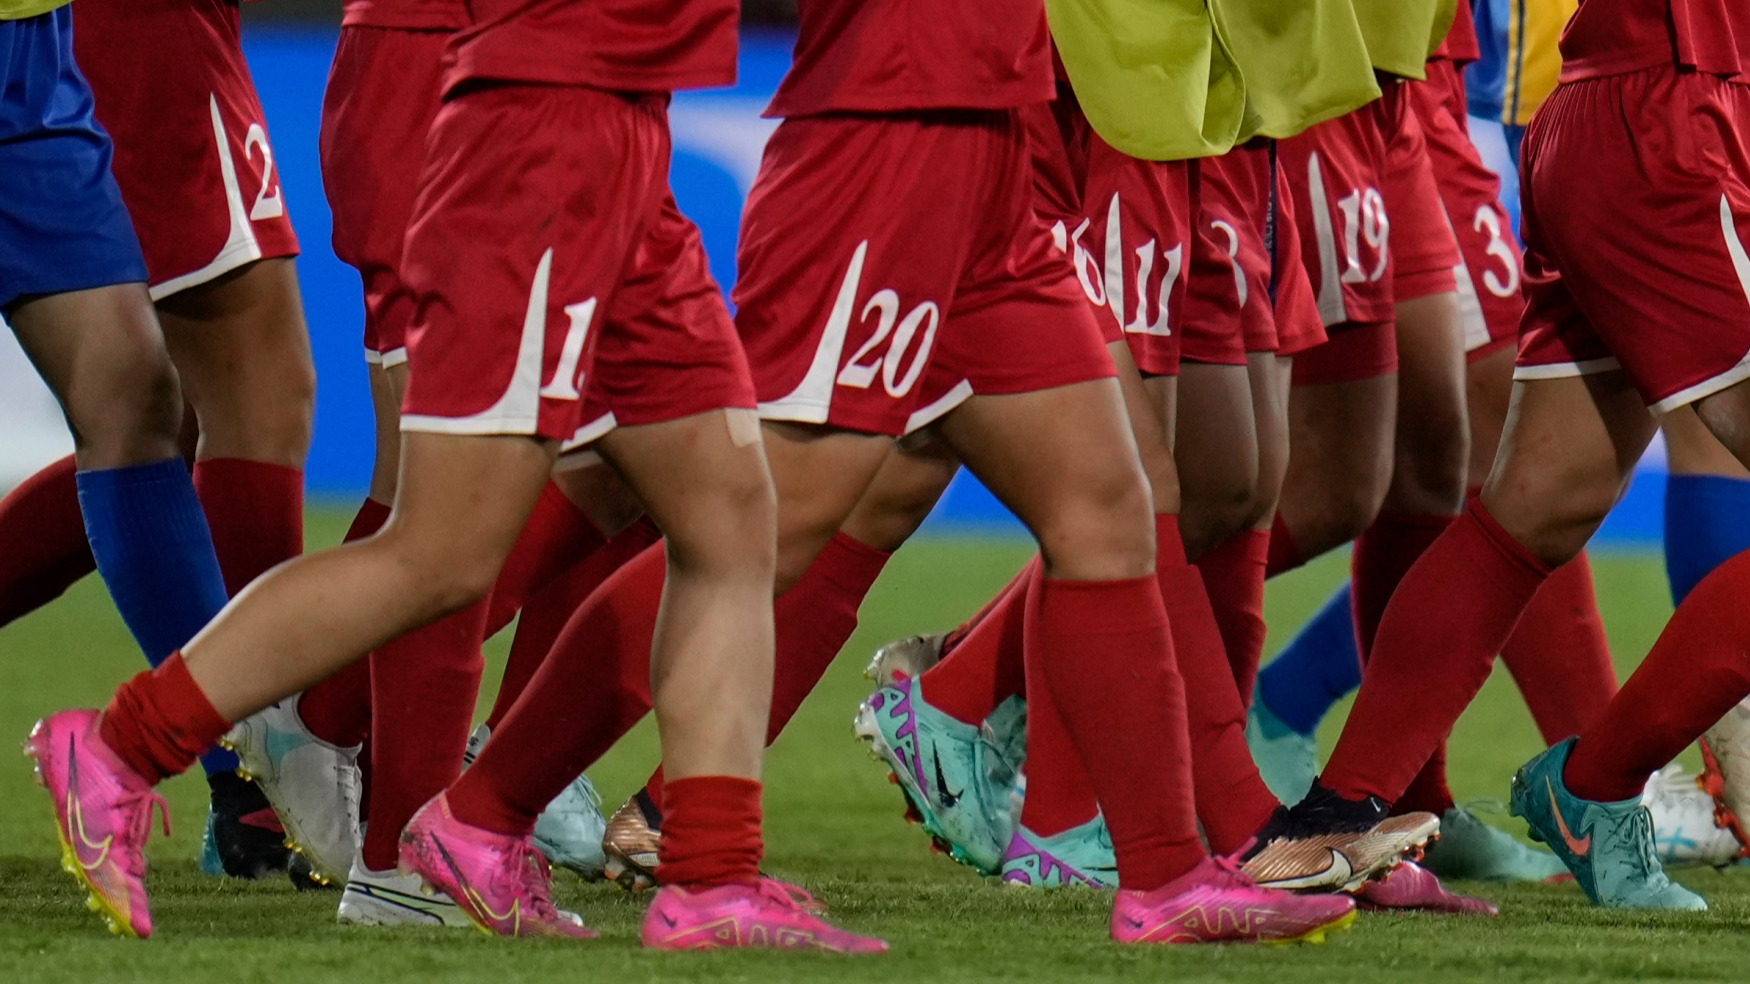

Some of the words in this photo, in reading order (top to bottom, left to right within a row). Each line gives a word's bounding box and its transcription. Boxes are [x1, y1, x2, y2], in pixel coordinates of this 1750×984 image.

[245, 123, 283, 221] 2
[1337, 187, 1390, 284] 19
[1474, 204, 1519, 298] 3
[1124, 237, 1182, 336] 11
[836, 287, 939, 398] 20
